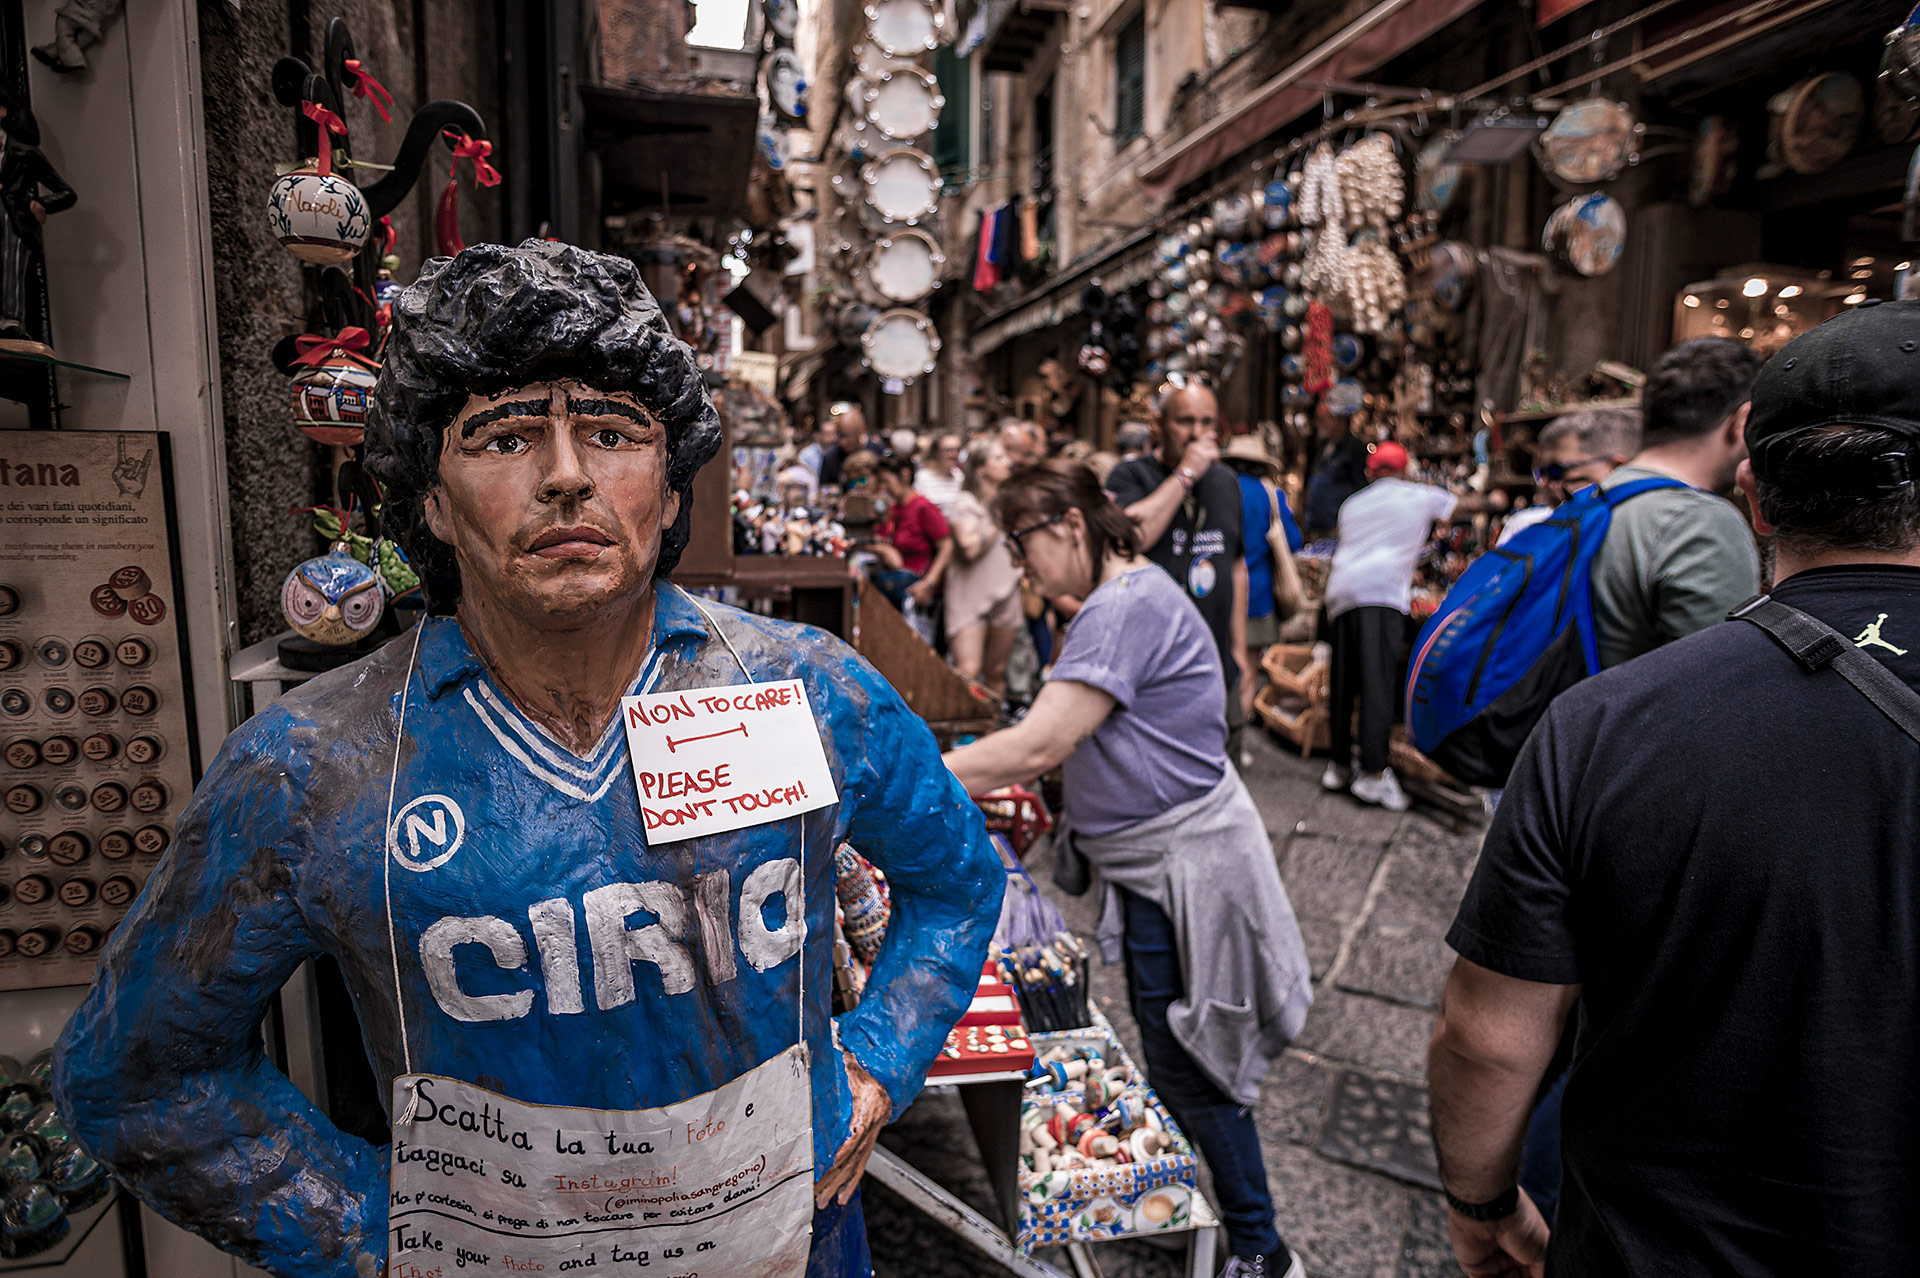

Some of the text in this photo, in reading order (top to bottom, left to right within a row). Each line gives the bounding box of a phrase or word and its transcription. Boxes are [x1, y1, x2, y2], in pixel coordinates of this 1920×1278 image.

[288, 190, 344, 227] Napoli
[6, 501, 25, 511] dei
[28, 502, 49, 511] vari
[52, 501, 75, 511] fatti
[77, 501, 136, 513] quotidiani,
[5, 514, 72, 526] corrisponde
[74, 516, 89, 524] un
[91, 514, 149, 527] significato
[61, 542, 83, 550] them
[86, 542, 95, 550] in
[97, 542, 136, 550] numbers
[137, 544, 154, 553] you
[135, 598, 159, 618] 80
[82, 647, 97, 658] 17
[122, 646, 137, 656] 18
[83, 696, 98, 706] 29
[128, 693, 144, 705] 30
[629, 684, 802, 729] NON TOCCARE!
[48, 743, 63, 753] 40
[88, 742, 102, 751] 41
[134, 743, 147, 755] 42
[640, 764, 731, 799] PLEASE
[12, 792, 28, 803] 51
[97, 790, 113, 804] 53
[138, 791, 153, 802] 54
[722, 780, 809, 814] TOUCH!
[139, 832, 154, 845] 66
[406, 809, 448, 857] N
[58, 840, 77, 855] 64
[107, 839, 122, 849] 65
[24, 881, 40, 894] 75
[66, 885, 82, 896] 76
[418, 857, 808, 1022] CIRIO
[412, 1079, 755, 1155] Scatta la tua Foto e
[395, 1140, 677, 1194] taggaci su Instagram!
[390, 1191, 411, 1207] Ma
[428, 1192, 477, 1216] cortesia,
[482, 1209, 494, 1220] si
[497, 1213, 531, 1230] prega
[536, 1217, 549, 1229] di
[557, 1217, 580, 1227] non
[583, 1211, 634, 1223] toccare
[643, 1211, 662, 1221] per
[669, 1202, 715, 1218] evitare
[722, 1175, 761, 1203] danni!
[389, 1223, 717, 1272] Take your Photo and tag us on
